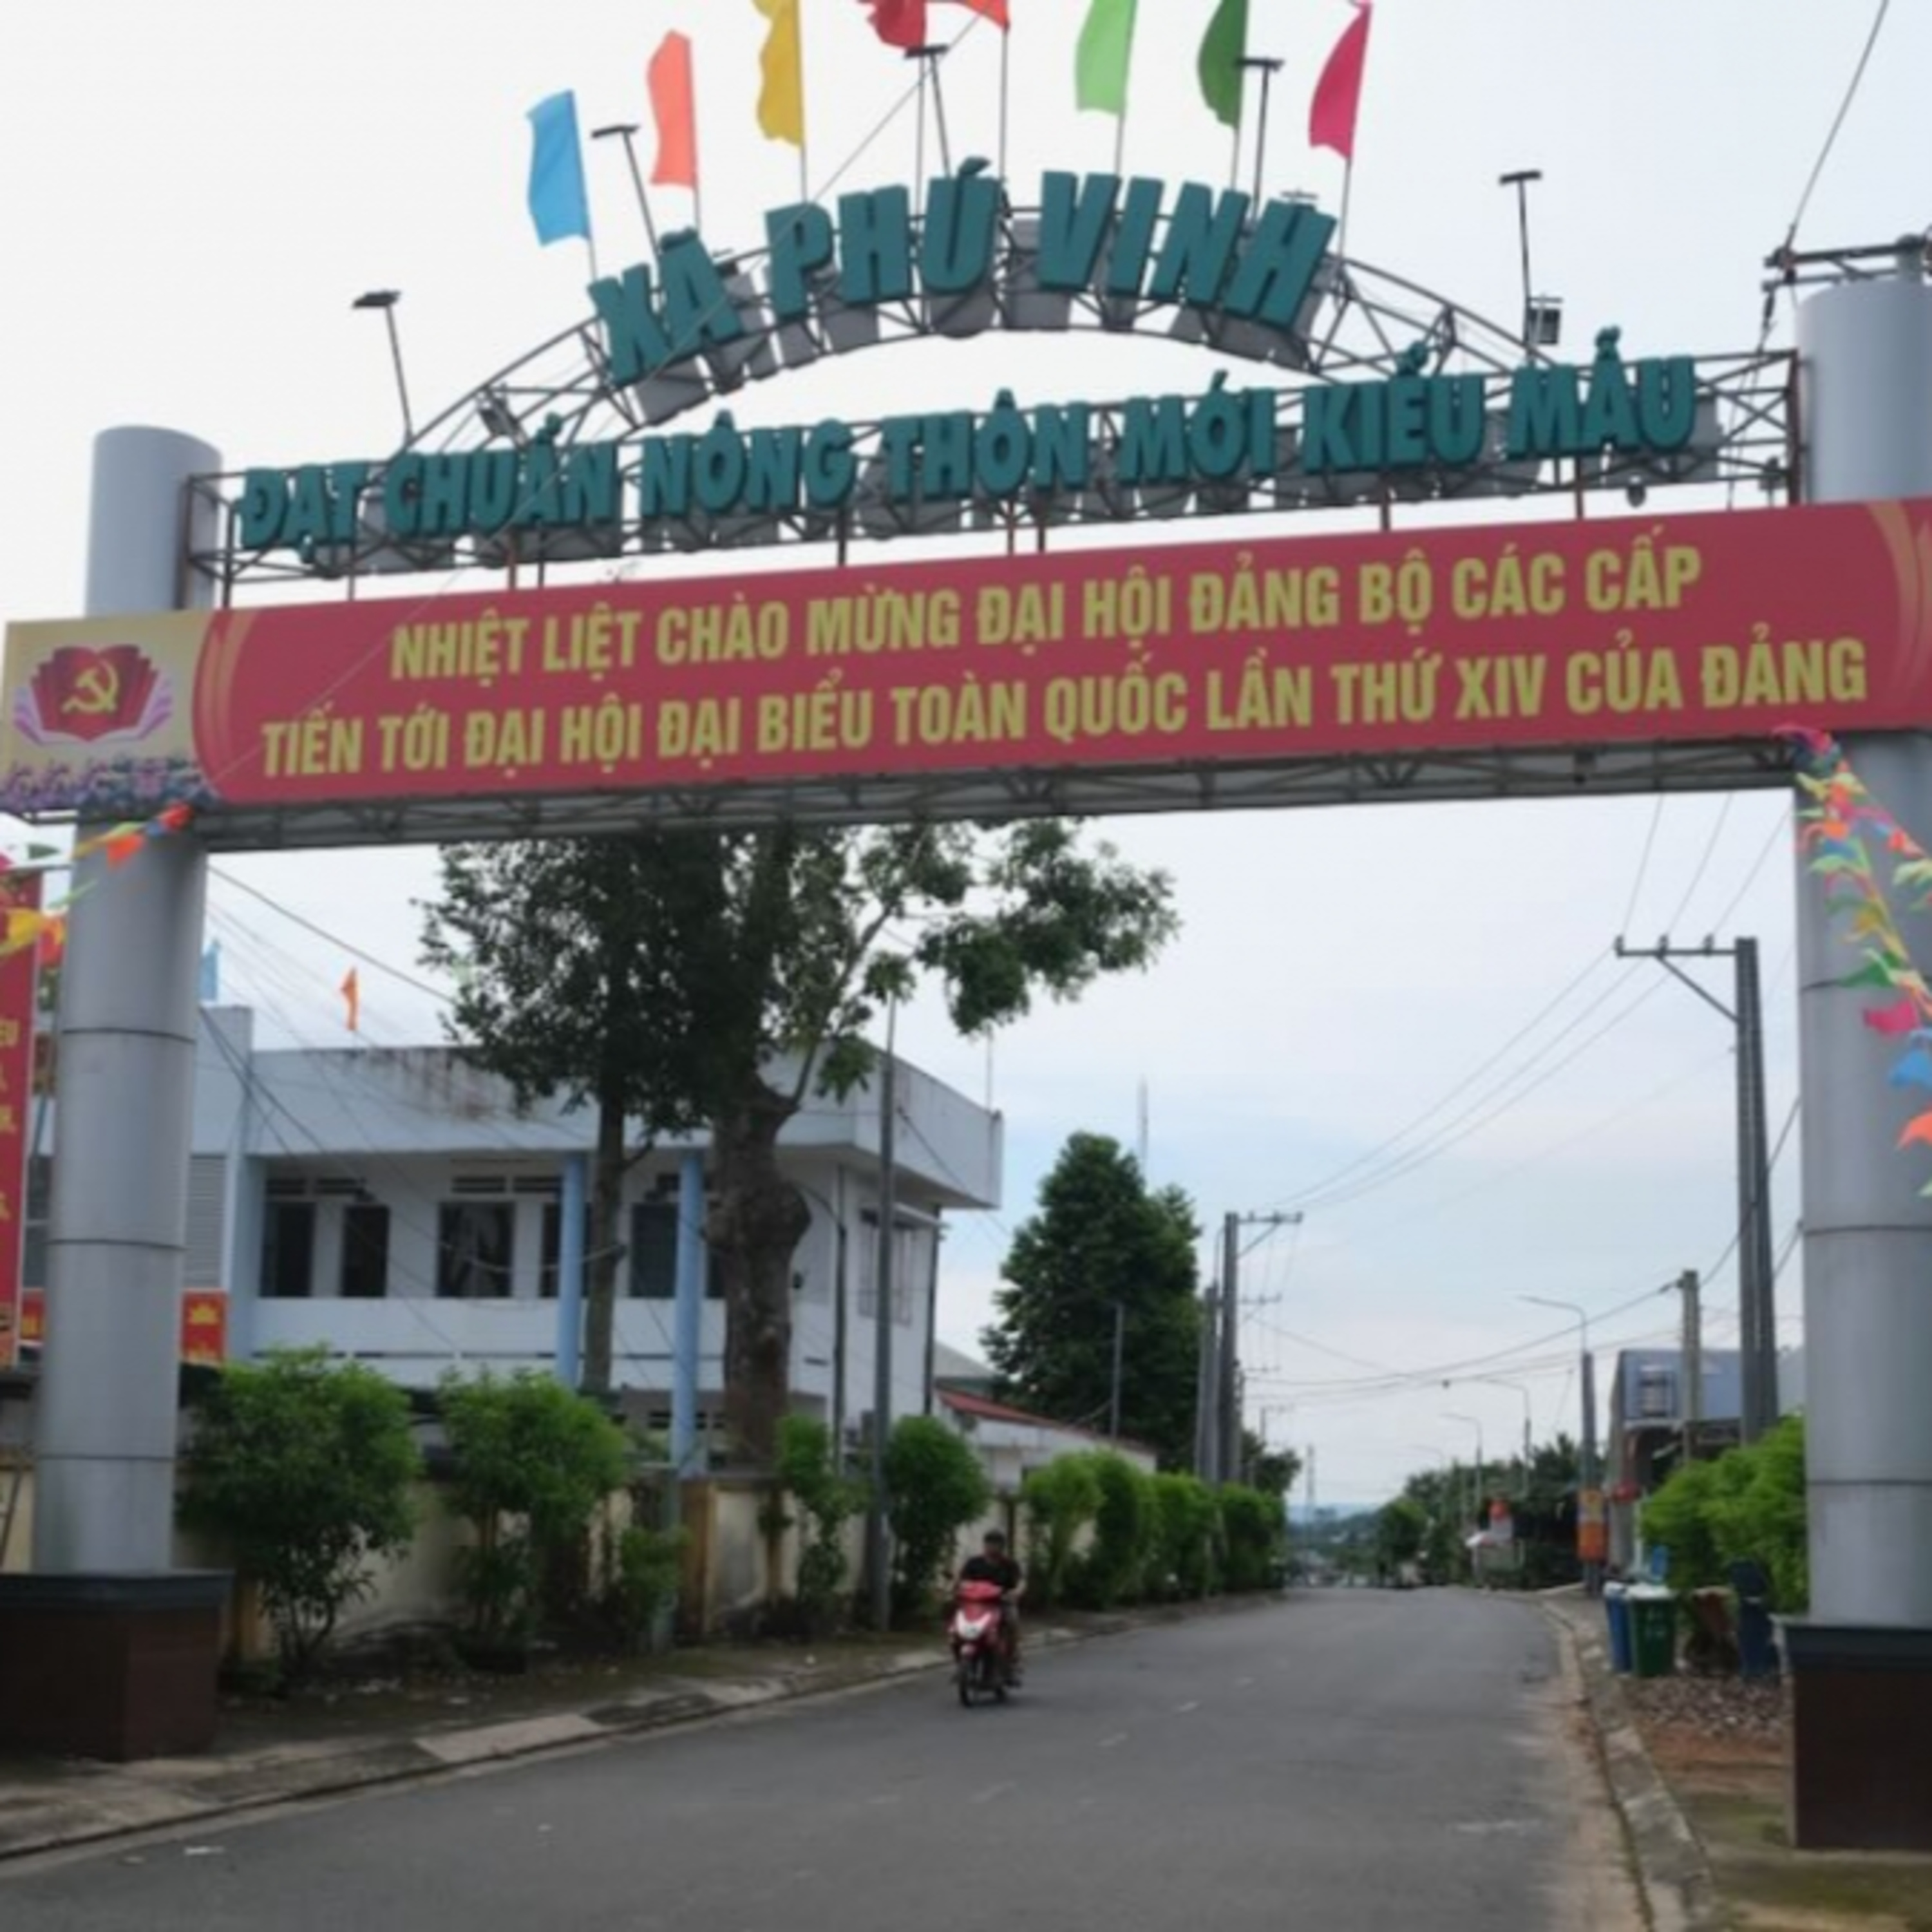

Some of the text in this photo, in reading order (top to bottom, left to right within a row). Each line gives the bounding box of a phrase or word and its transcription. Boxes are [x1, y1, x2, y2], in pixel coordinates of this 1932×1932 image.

[765, 156, 1002, 321] PHÚ
[1039, 170, 1337, 326] VINH
[237, 460, 370, 564] ĐẠT
[640, 410, 859, 515] NÔNG
[878, 388, 1091, 501] THÔN
[391, 526, 1701, 687] NHIỆT LIỆT CHÀO MỪNG ĐẠI HỘI ĐẢNG BỘ CÁC CẤP
[263, 622, 1866, 777] TIẾN TỚI ĐẠI HỘI ĐẠI BIỂU TOÀN QUỐC LẦN THỨ XIV CỦA ĐẢNG
